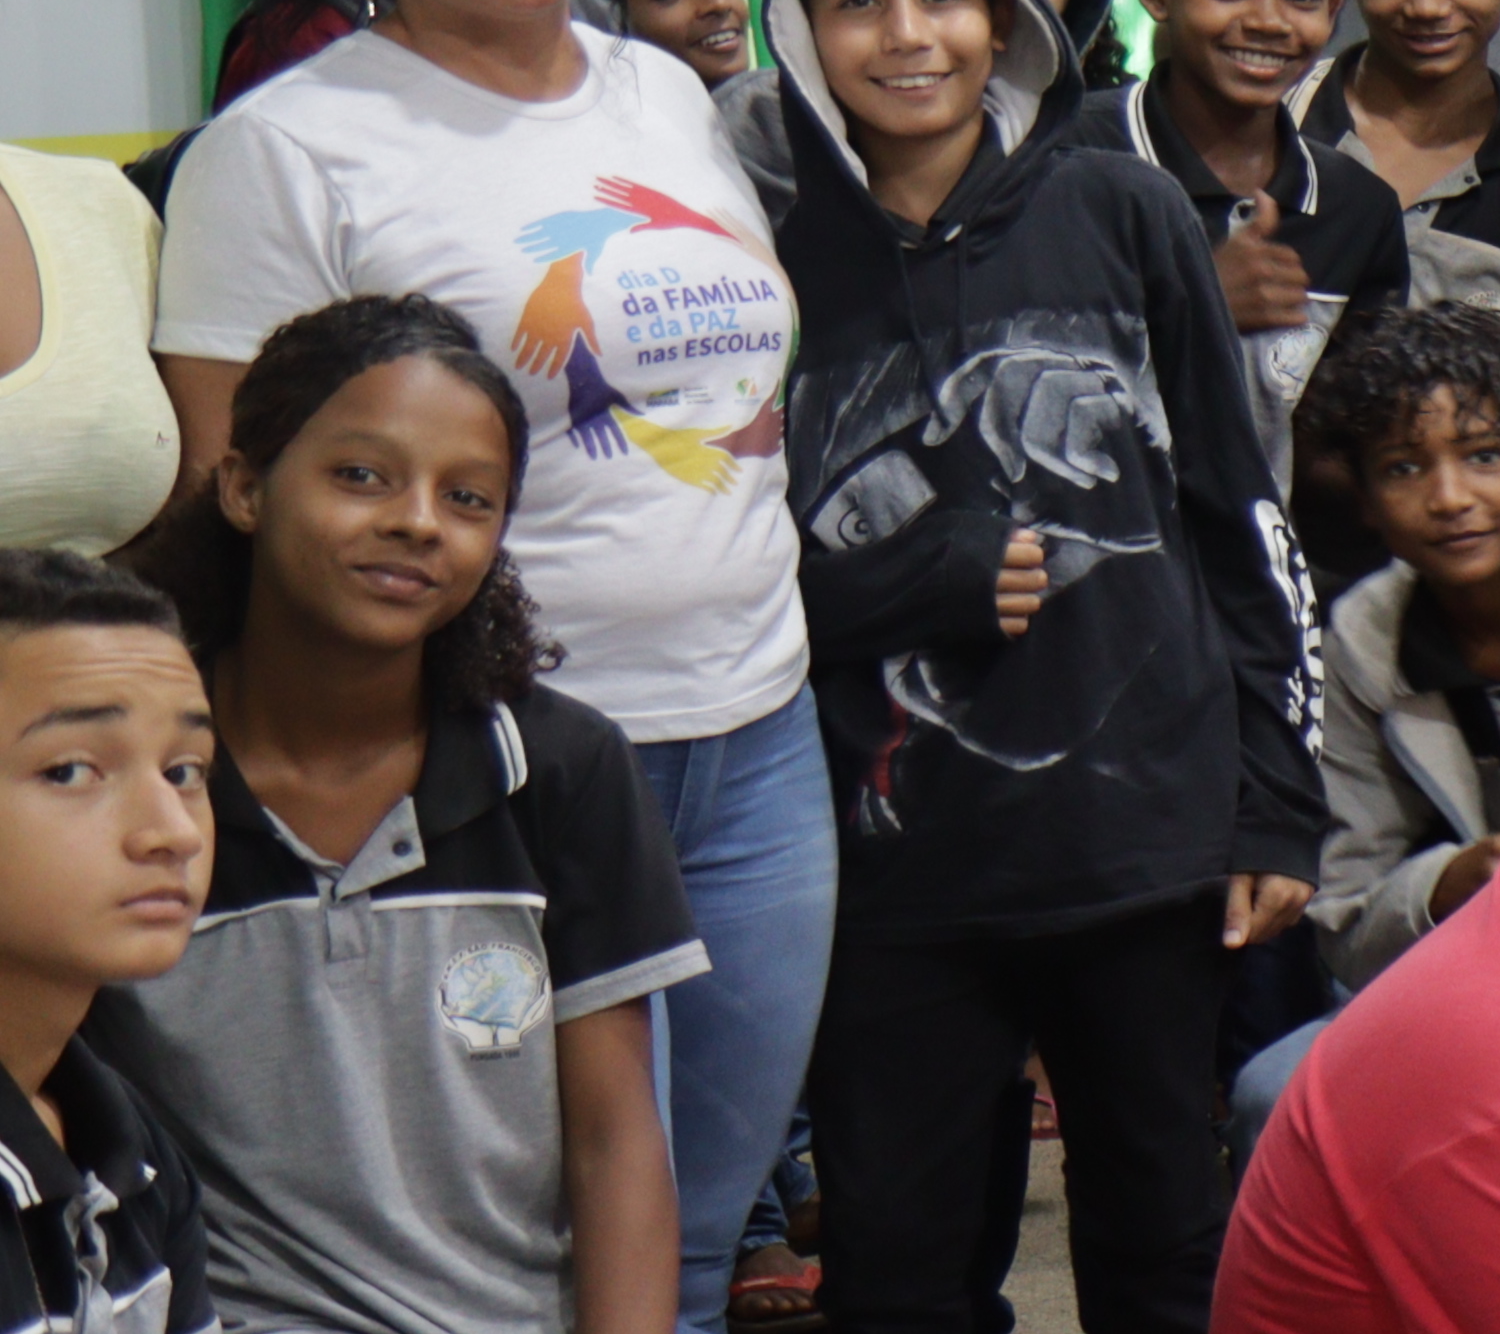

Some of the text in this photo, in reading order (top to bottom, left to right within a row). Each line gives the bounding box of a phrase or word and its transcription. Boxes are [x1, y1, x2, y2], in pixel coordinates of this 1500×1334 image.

[617, 267, 682, 290] dia D
[622, 275, 778, 316] da FAMÍLIA
[626, 308, 741, 343] e da PAZ
[638, 332, 782, 366] nas ESCOLAS
